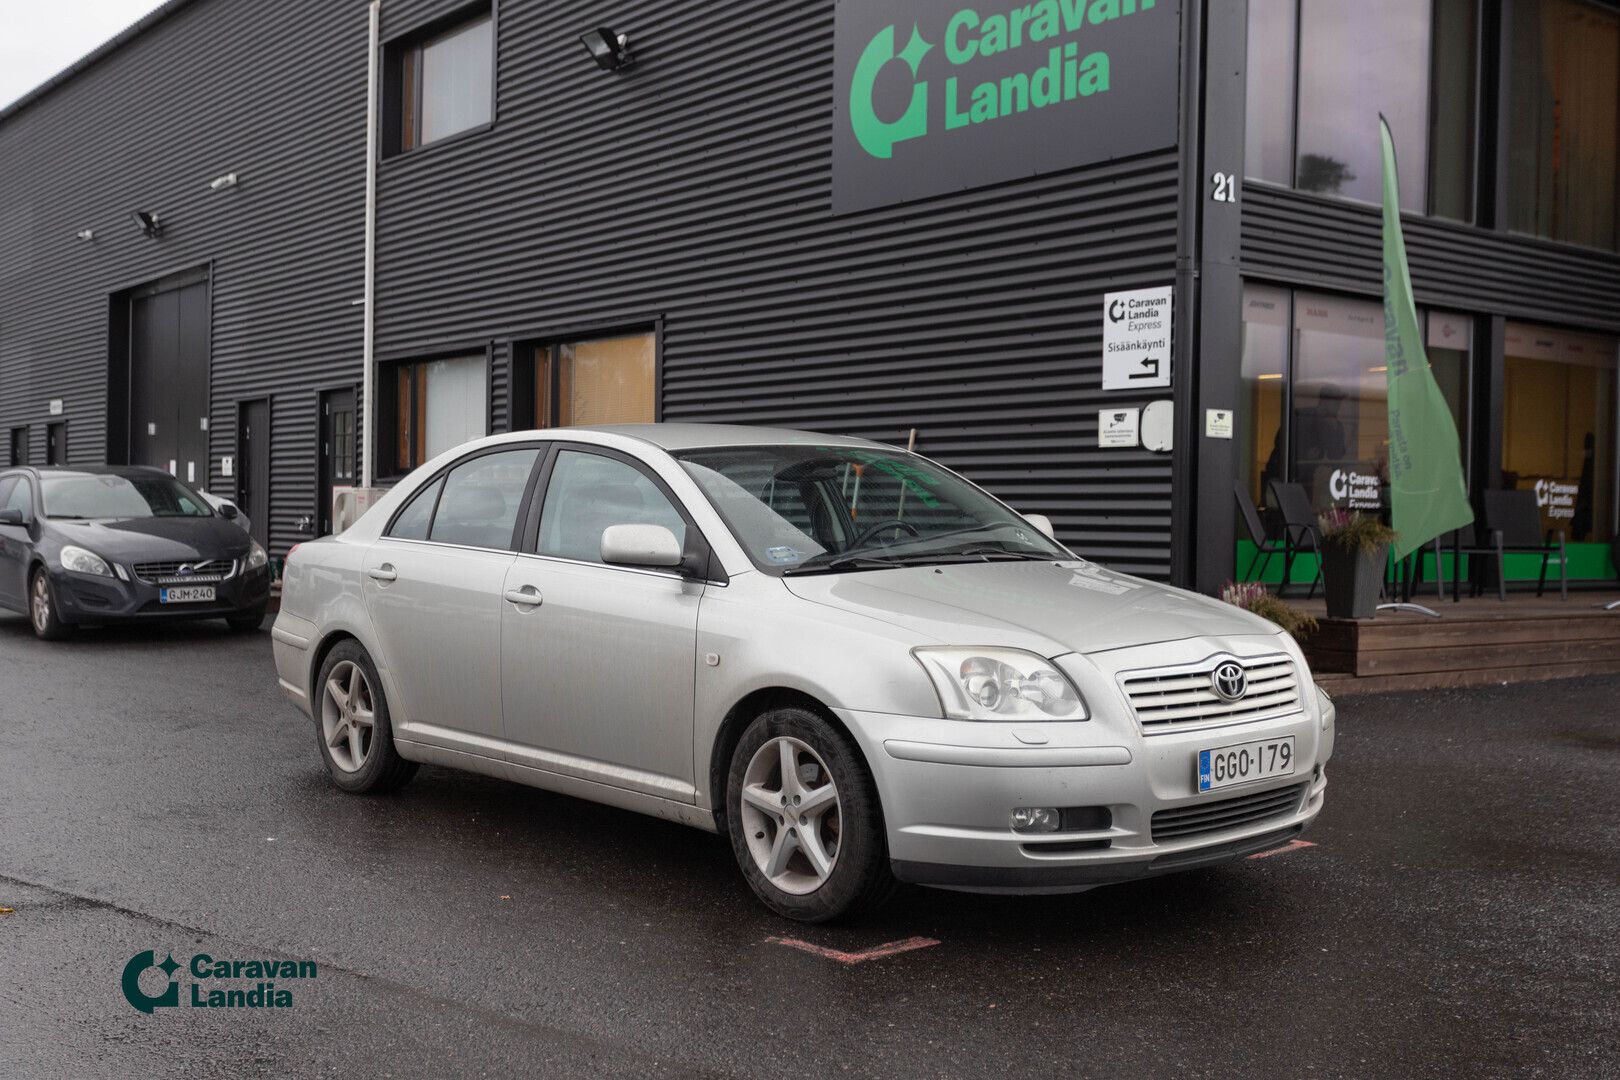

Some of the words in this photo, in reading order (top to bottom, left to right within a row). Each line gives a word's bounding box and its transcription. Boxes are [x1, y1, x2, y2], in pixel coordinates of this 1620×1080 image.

[945, 41, 1110, 130] Landia
[1213, 172, 1236, 203] 21
[1128, 298, 1167, 309] Caravan
[1128, 308, 1159, 320] Landia
[1128, 321, 1162, 332] Express
[1108, 338, 1166, 353] Sisäänkäynti
[1349, 485, 1378, 499] Landia
[169, 588, 213, 600] GJM-240
[1215, 742, 1291, 781] GGO-179
